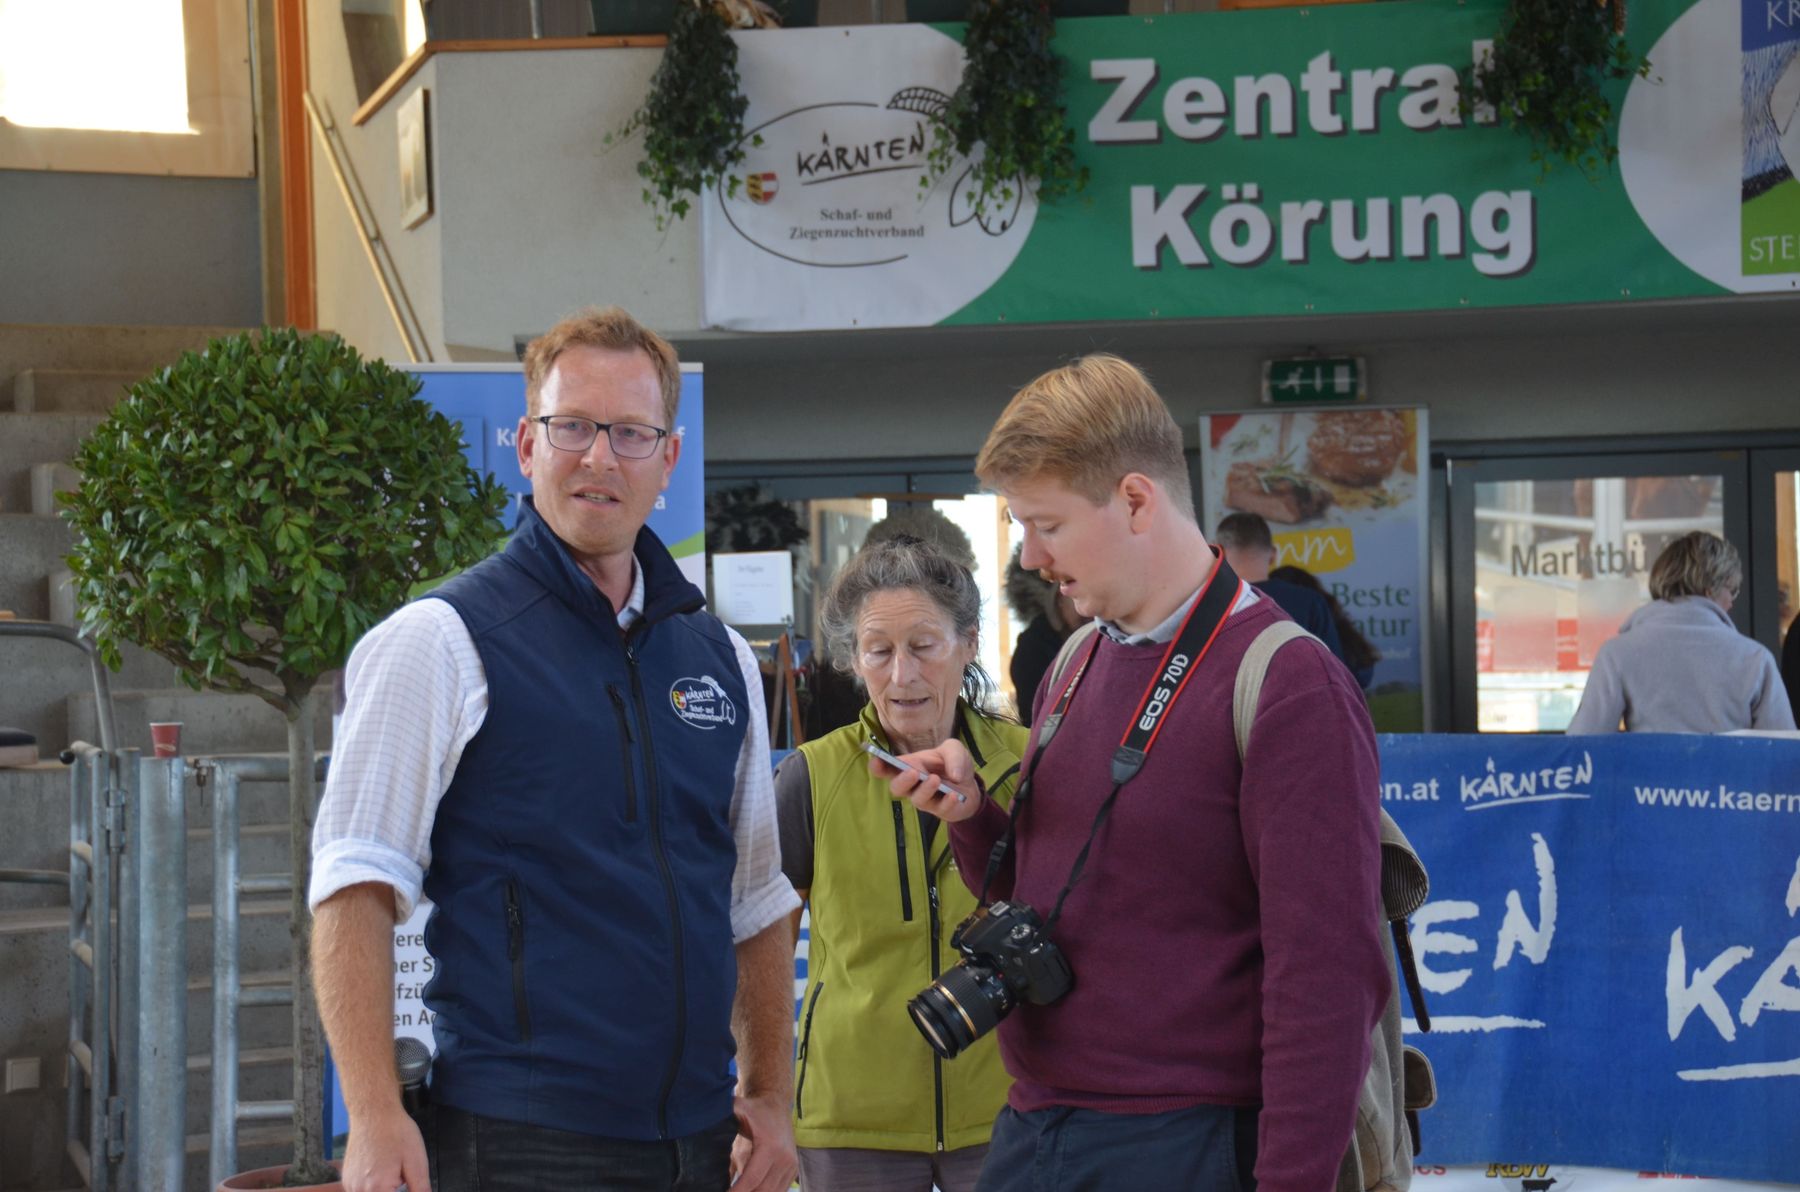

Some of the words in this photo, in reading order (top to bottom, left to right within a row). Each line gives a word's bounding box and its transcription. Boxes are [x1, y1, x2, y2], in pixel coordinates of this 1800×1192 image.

[797, 120, 925, 177] KÄRNTEN
[790, 225, 925, 241] Ziegenzuchtverband
[820, 208, 863, 221] Schaf-
[867, 207, 892, 221] und
[1130, 182, 1537, 277] Körung
[1331, 582, 1410, 608] Beste
[1139, 686, 1171, 731] EOS
[1162, 653, 1190, 685] 70D
[1380, 778, 1440, 801] n.at
[1460, 751, 1593, 803] KÄRNTEN
